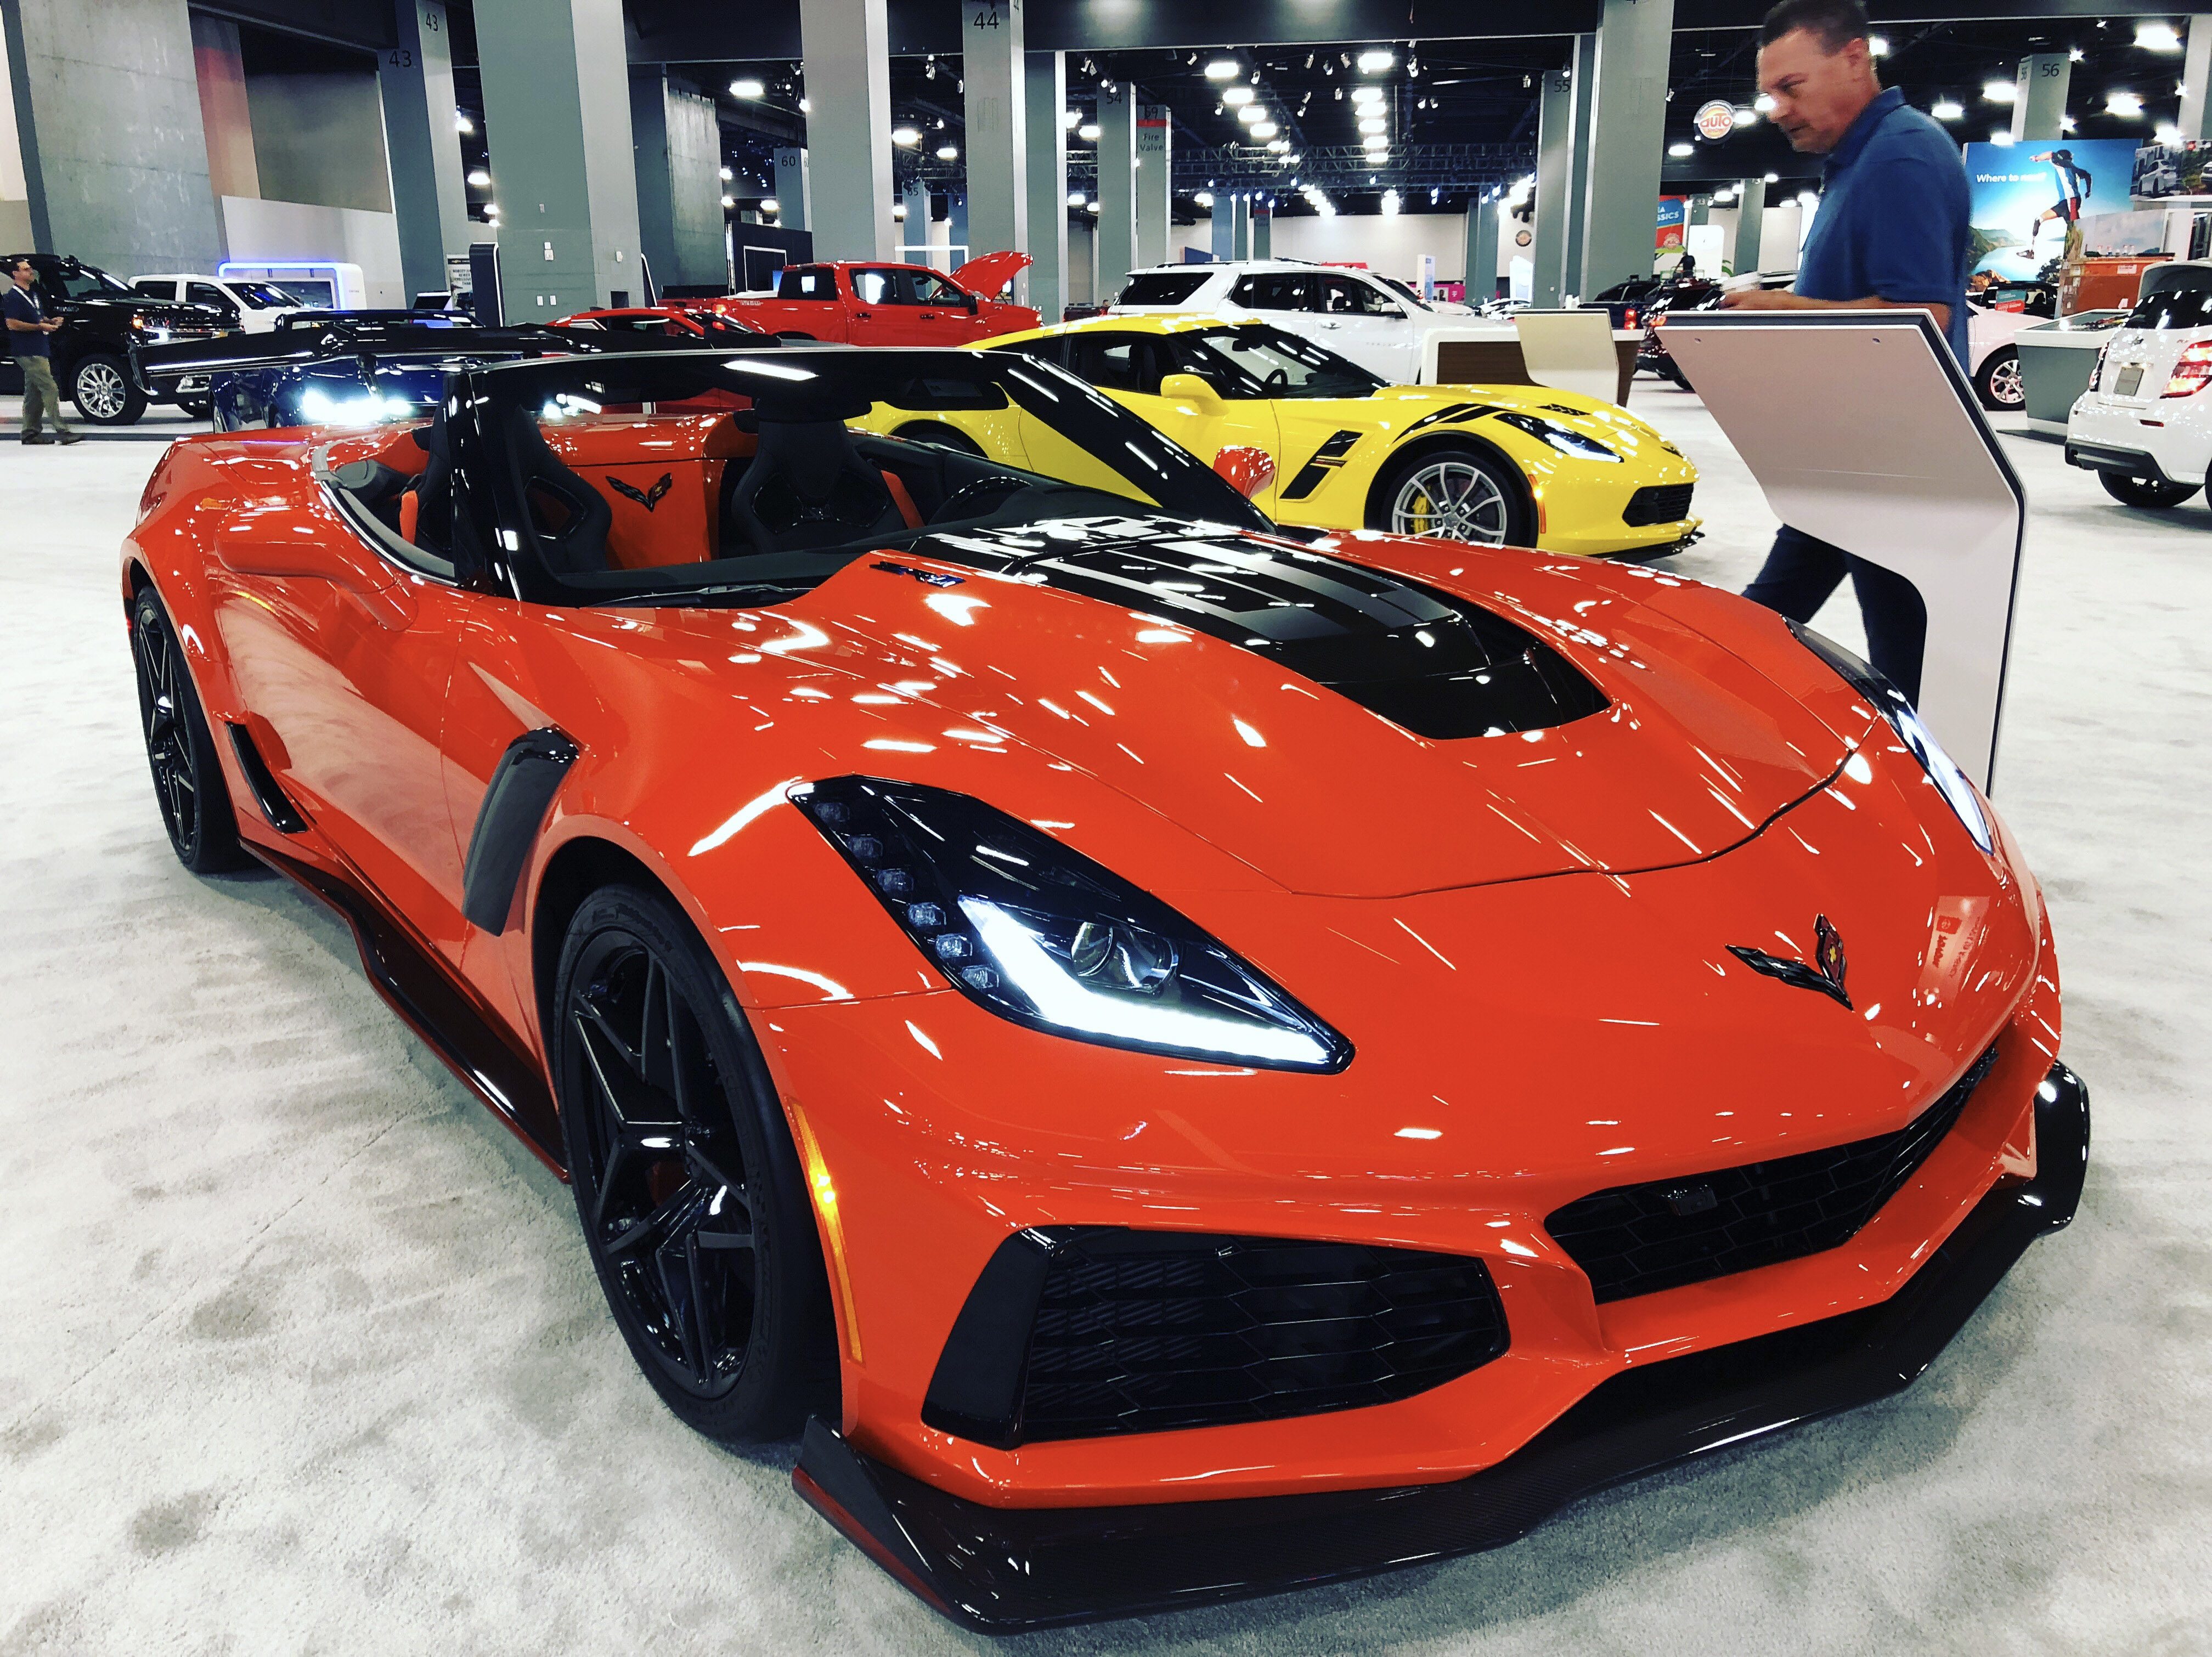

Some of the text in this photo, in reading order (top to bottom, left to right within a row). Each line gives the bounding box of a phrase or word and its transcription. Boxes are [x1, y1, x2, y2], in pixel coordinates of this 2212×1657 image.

[426, 13, 439, 32] 43
[973, 12, 1000, 30] 44
[388, 49, 412, 67] 43
[2041, 63, 2060, 77] 56
[1554, 80, 1571, 93] 55
[1106, 92, 1122, 104] 54
[1143, 132, 1160, 142] Fire
[1139, 143, 1164, 152] Valve
[781, 155, 796, 167] 60
[1976, 173, 2007, 183] Where
